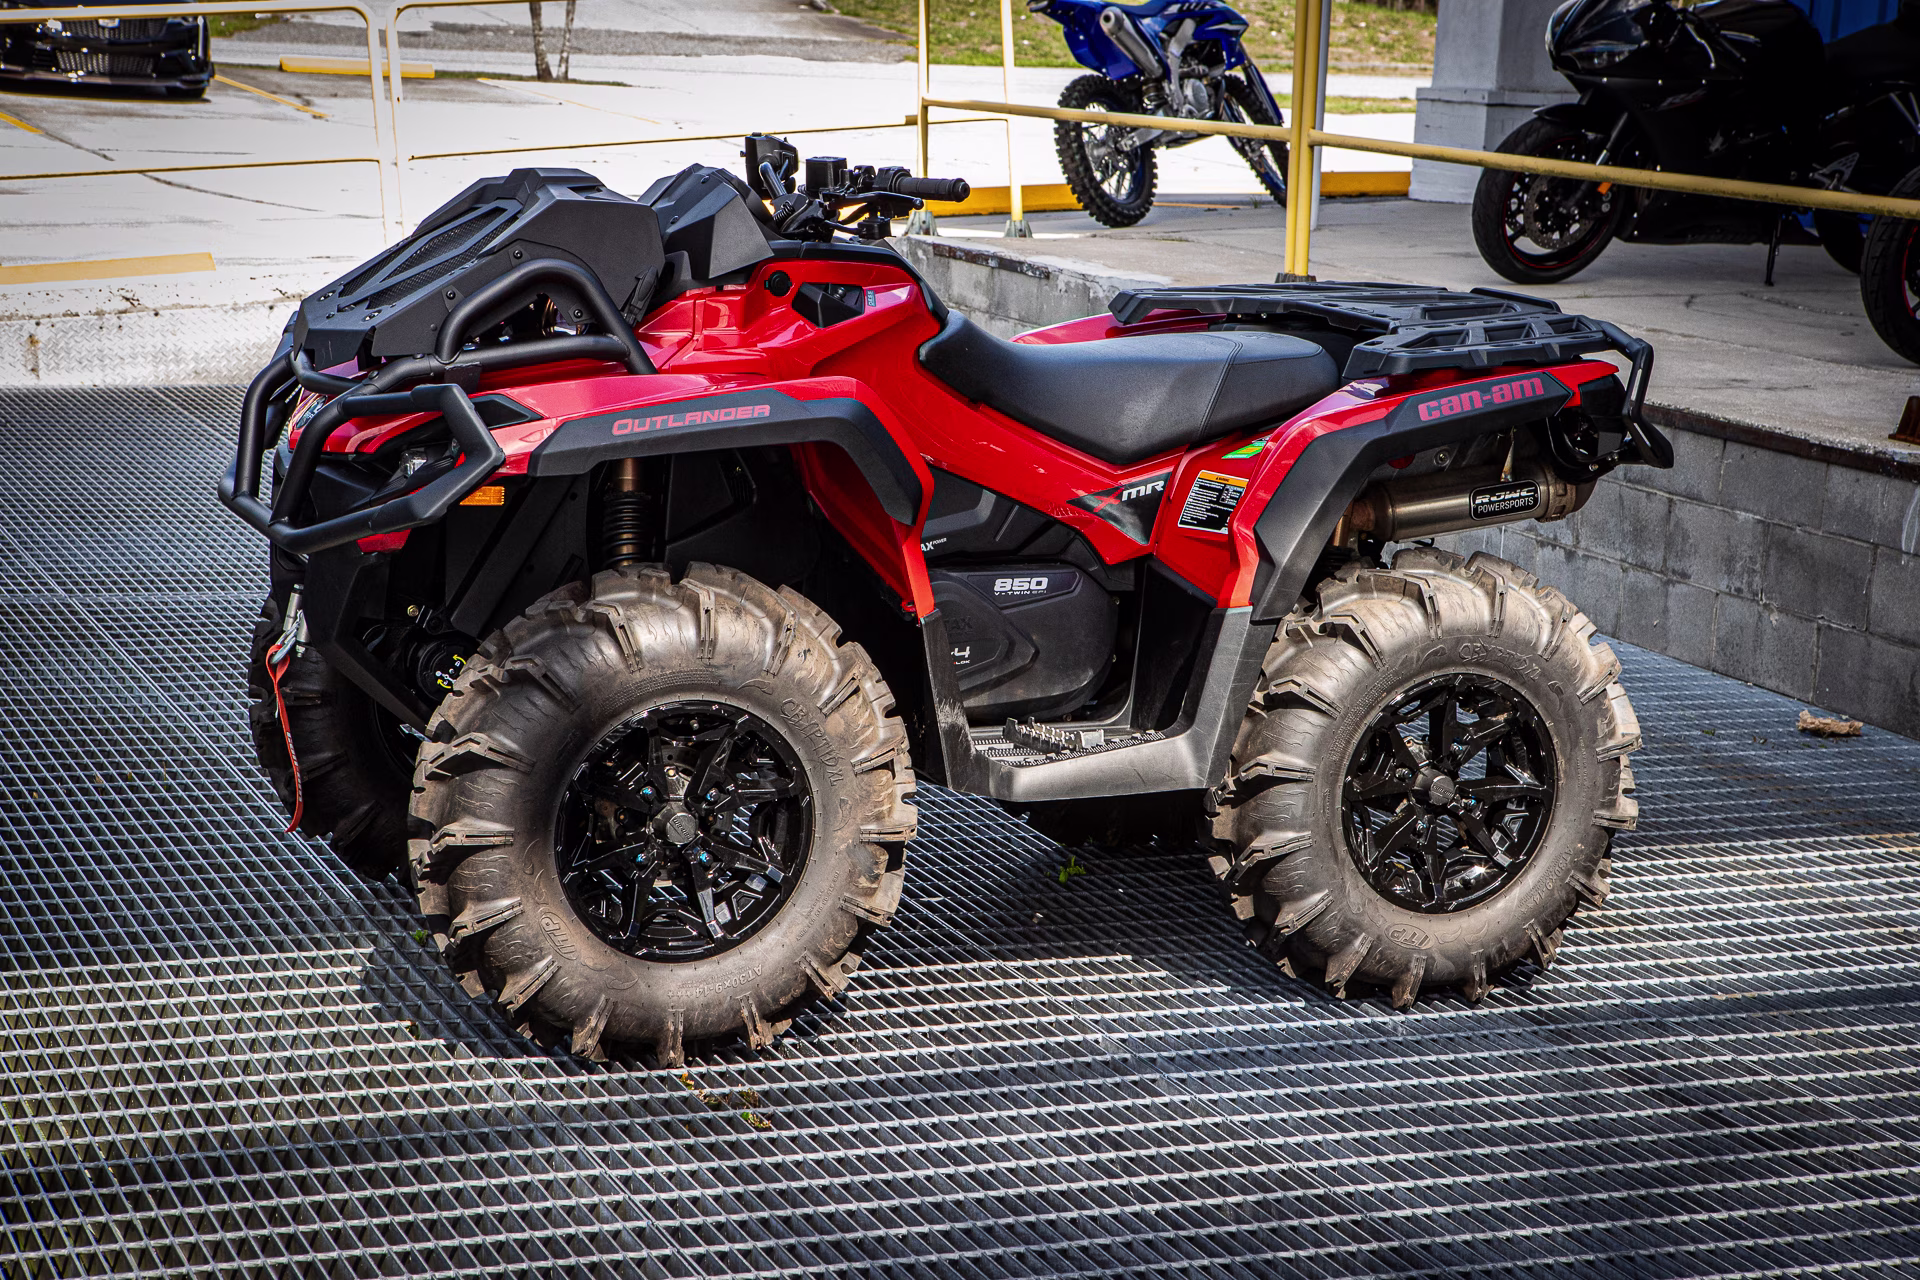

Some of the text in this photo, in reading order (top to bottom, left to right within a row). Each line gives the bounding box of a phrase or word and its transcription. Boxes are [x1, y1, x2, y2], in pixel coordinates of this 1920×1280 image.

[1418, 378, 1544, 421] can-am
[612, 405, 770, 436] OUTLANDER
[1478, 497, 1534, 513] POWERSPORTS
[994, 577, 1048, 592] 850
[540, 915, 576, 954] ITP
[1390, 928, 1430, 947] ITP
[695, 964, 763, 998] AT30x9-14
